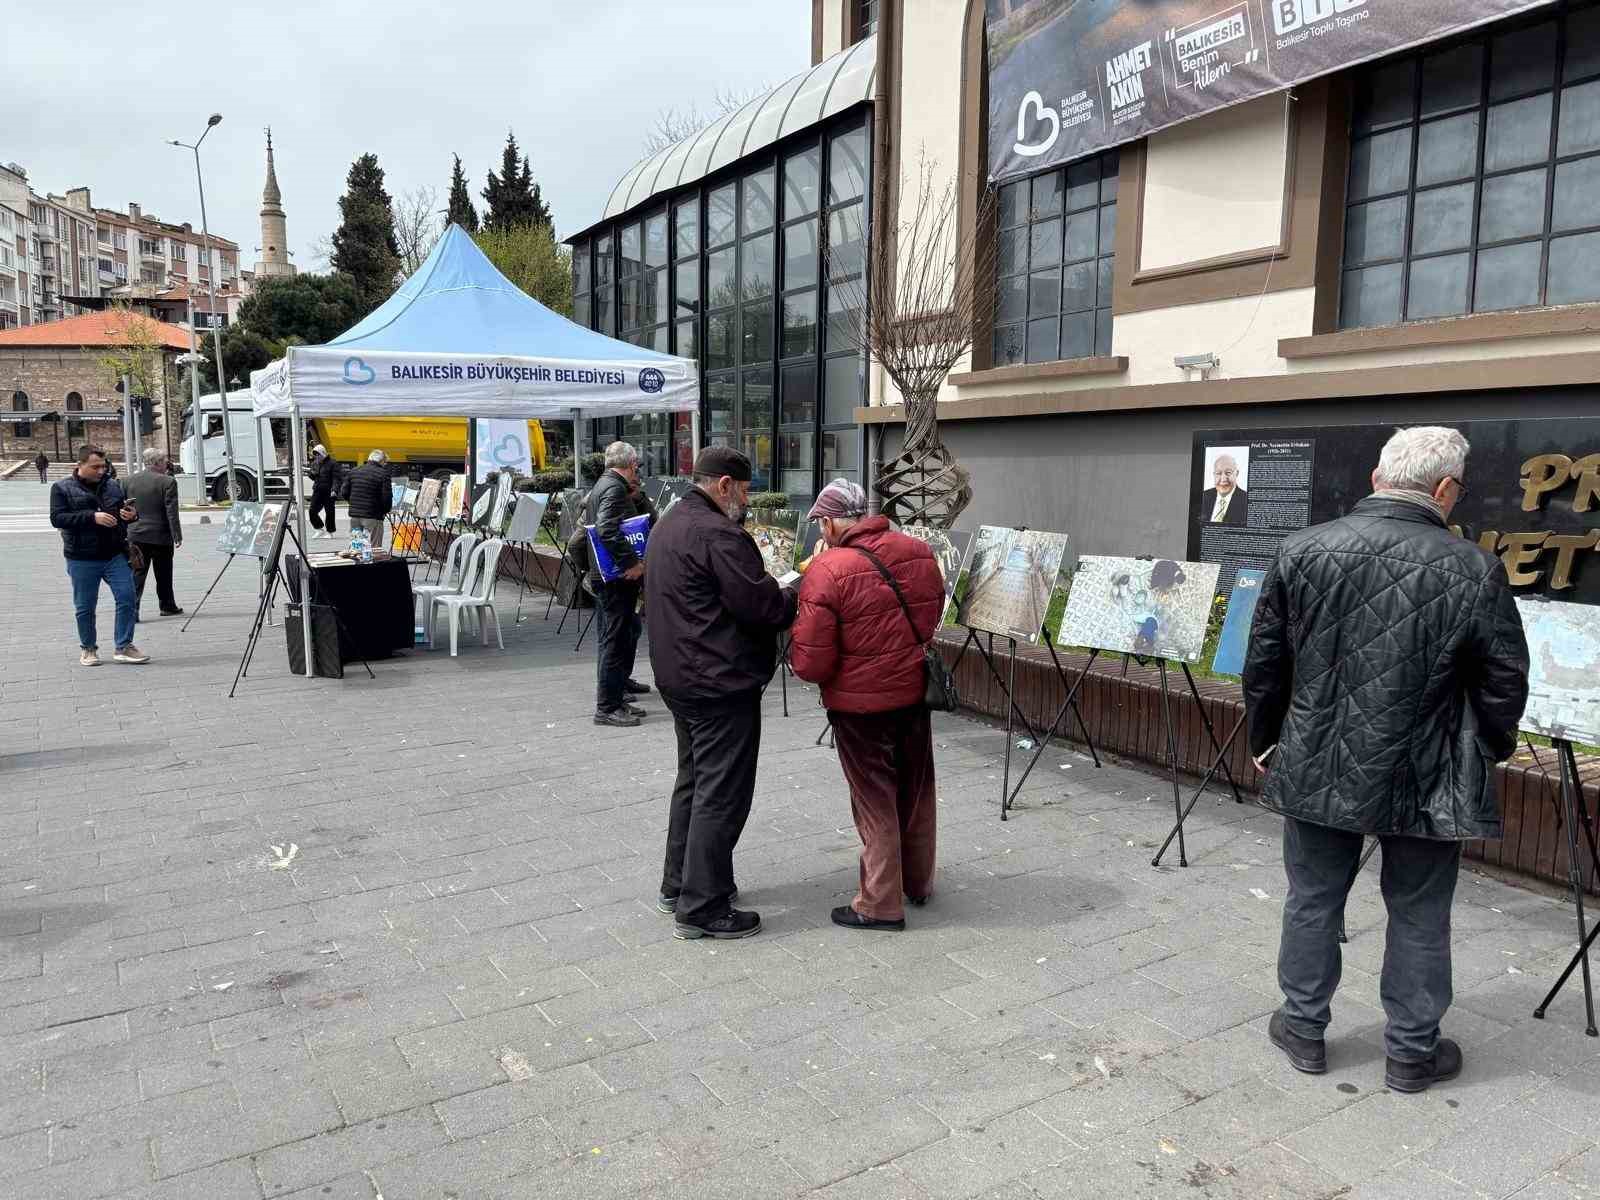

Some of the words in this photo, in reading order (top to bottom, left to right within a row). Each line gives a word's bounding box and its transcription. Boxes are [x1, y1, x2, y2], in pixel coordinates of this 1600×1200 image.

[1178, 20, 1242, 57] BALIKESİR
[1310, 22, 1334, 37] Toplu
[1336, 10, 1369, 28] Taşıma
[1106, 40, 1152, 87] AHMET
[1181, 50, 1219, 72] Benim
[1194, 61, 1231, 92] Ailem
[1111, 72, 1144, 111] AKIN
[392, 363, 463, 380] BALIKESİR
[467, 363, 551, 383] BÜYÜKŞEHİR
[555, 368, 625, 385] BELEDİYESİ
